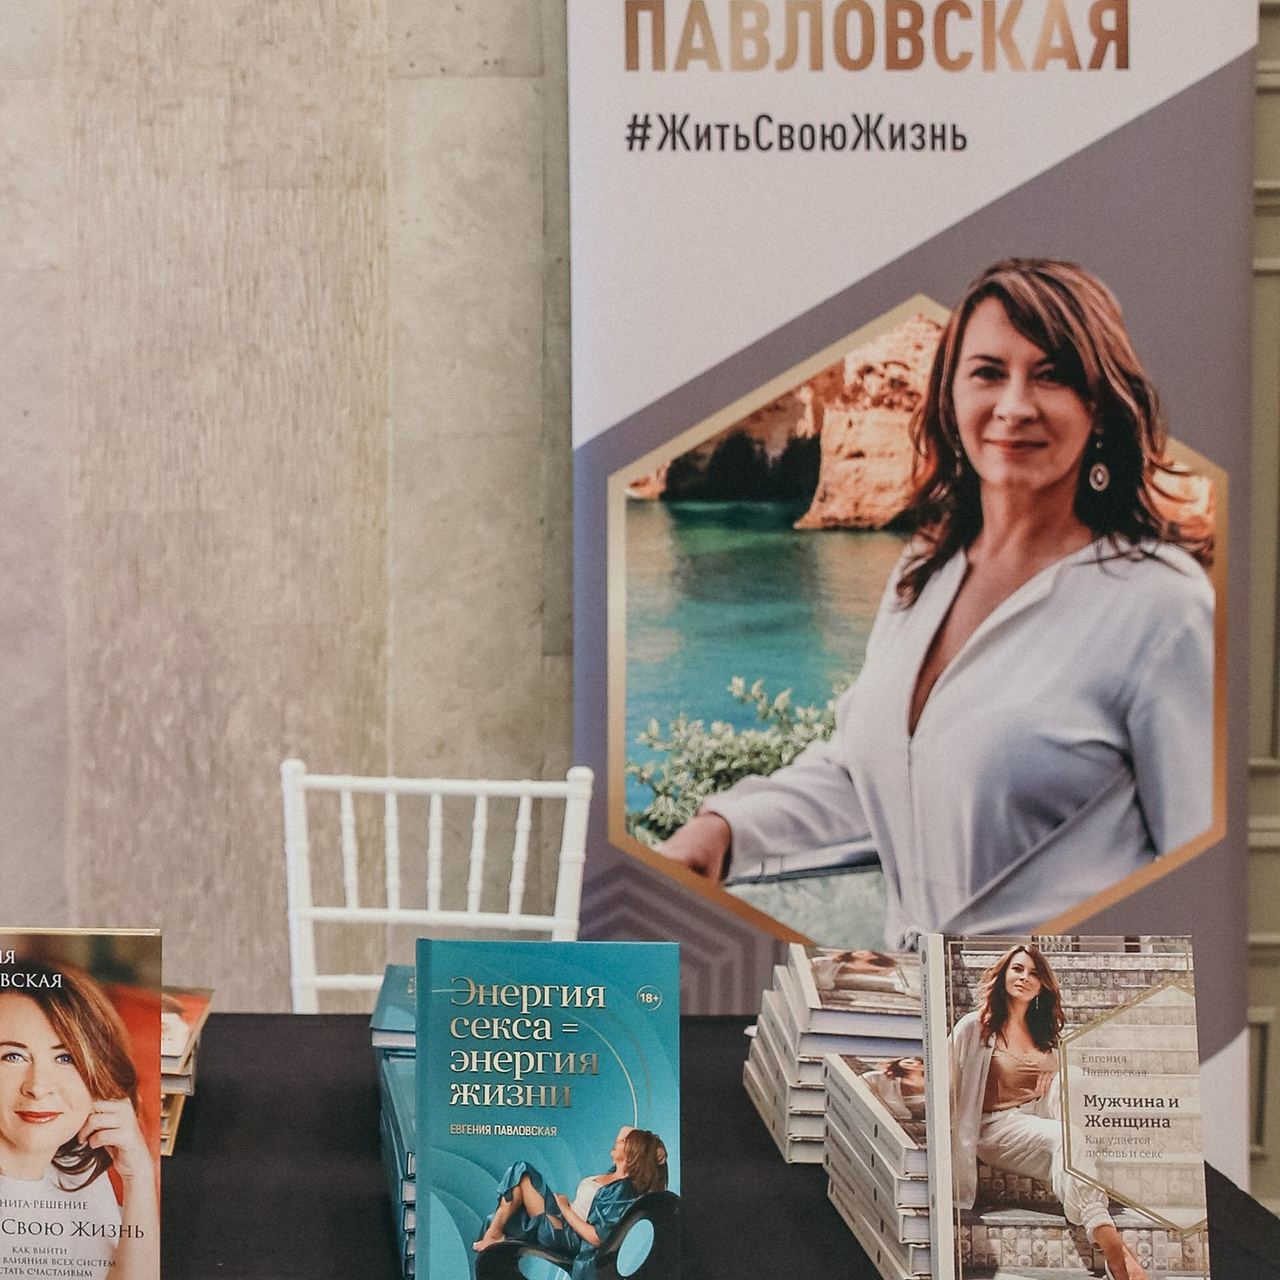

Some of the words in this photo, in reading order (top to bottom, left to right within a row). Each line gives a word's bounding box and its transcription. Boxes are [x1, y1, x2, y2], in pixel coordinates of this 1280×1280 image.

[626, 114, 967, 152] #ЖитьСвоюЖизнь
[450, 976, 607, 1014] Энергия
[639, 992, 659, 1003] 18+
[449, 1016, 553, 1041] секса
[1081, 1053, 1127, 1063] Евгения
[450, 1049, 599, 1081] энергия
[1082, 1066, 1148, 1077] Павловская
[448, 1083, 572, 1108] жизни
[1083, 1094, 1165, 1111] Мужчина
[1169, 1097, 1180, 1108] и
[1084, 1114, 1171, 1130] Женщина
[449, 1124, 491, 1135] ЕВГЕНИЯ
[494, 1124, 558, 1136] ПАВЛОВСКАЯ
[1085, 1135, 1105, 1144] Как
[1085, 1147, 1128, 1158] любовь
[1129, 1149, 1137, 1158] и
[1142, 1149, 1164, 1158] секс
[1, 1218, 64, 1236] СВОЮ
[70, 1221, 145, 1239] ЖИЗНЬ
[12, 1246, 31, 1254] КАК
[33, 1245, 67, 1255] ВЫЙТИ
[2, 1256, 48, 1265] ВЛИЯНИЯ
[51, 1258, 74, 1266] ВСЕХ
[76, 1258, 116, 1267] СИСТЕМ
[26, 1267, 93, 1277] СЧАСТЛИВЫМ
